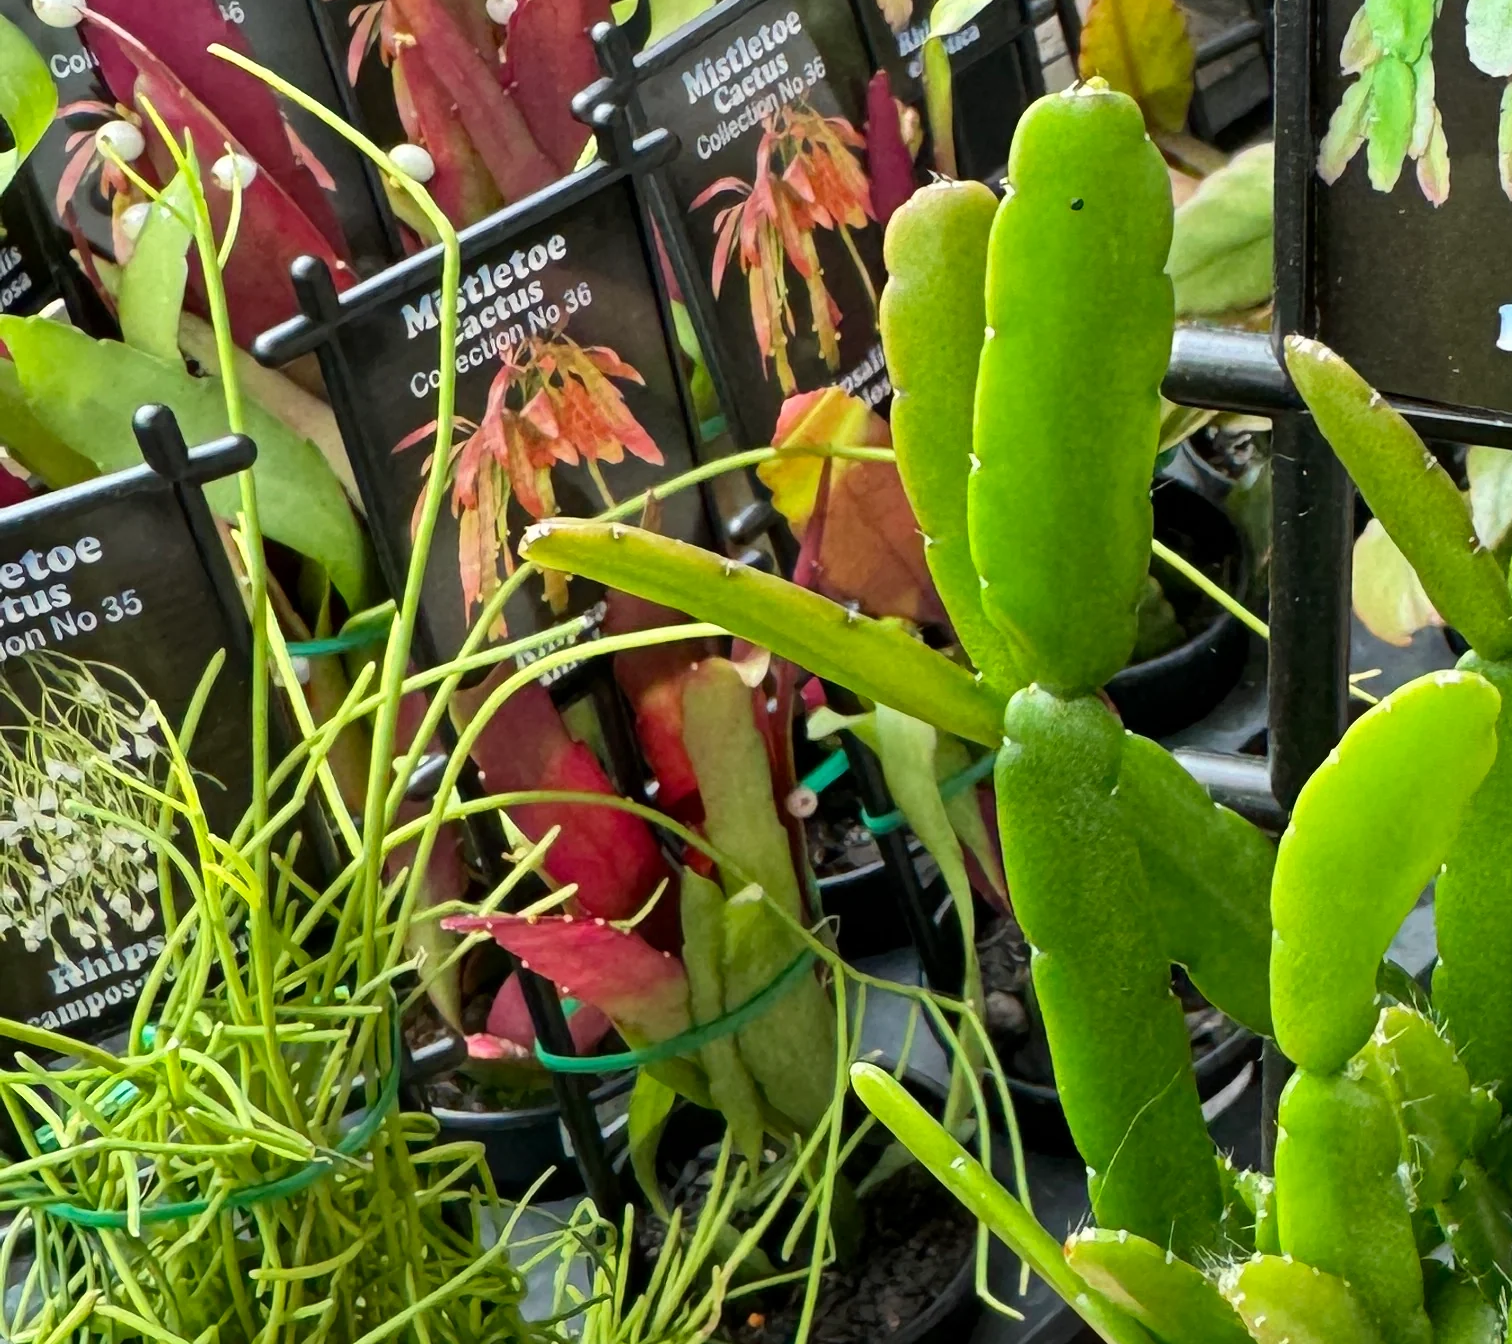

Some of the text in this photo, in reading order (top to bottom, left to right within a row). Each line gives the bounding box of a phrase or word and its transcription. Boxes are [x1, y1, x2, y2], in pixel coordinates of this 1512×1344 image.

[682, 11, 802, 104] Mistletoe
[713, 52, 789, 114] Cactus
[697, 56, 826, 159] Collection No 36
[410, 282, 592, 398] Coection No 36
[455, 280, 544, 346] actus
[50, 610, 98, 641] No
[101, 589, 143, 622] 35
